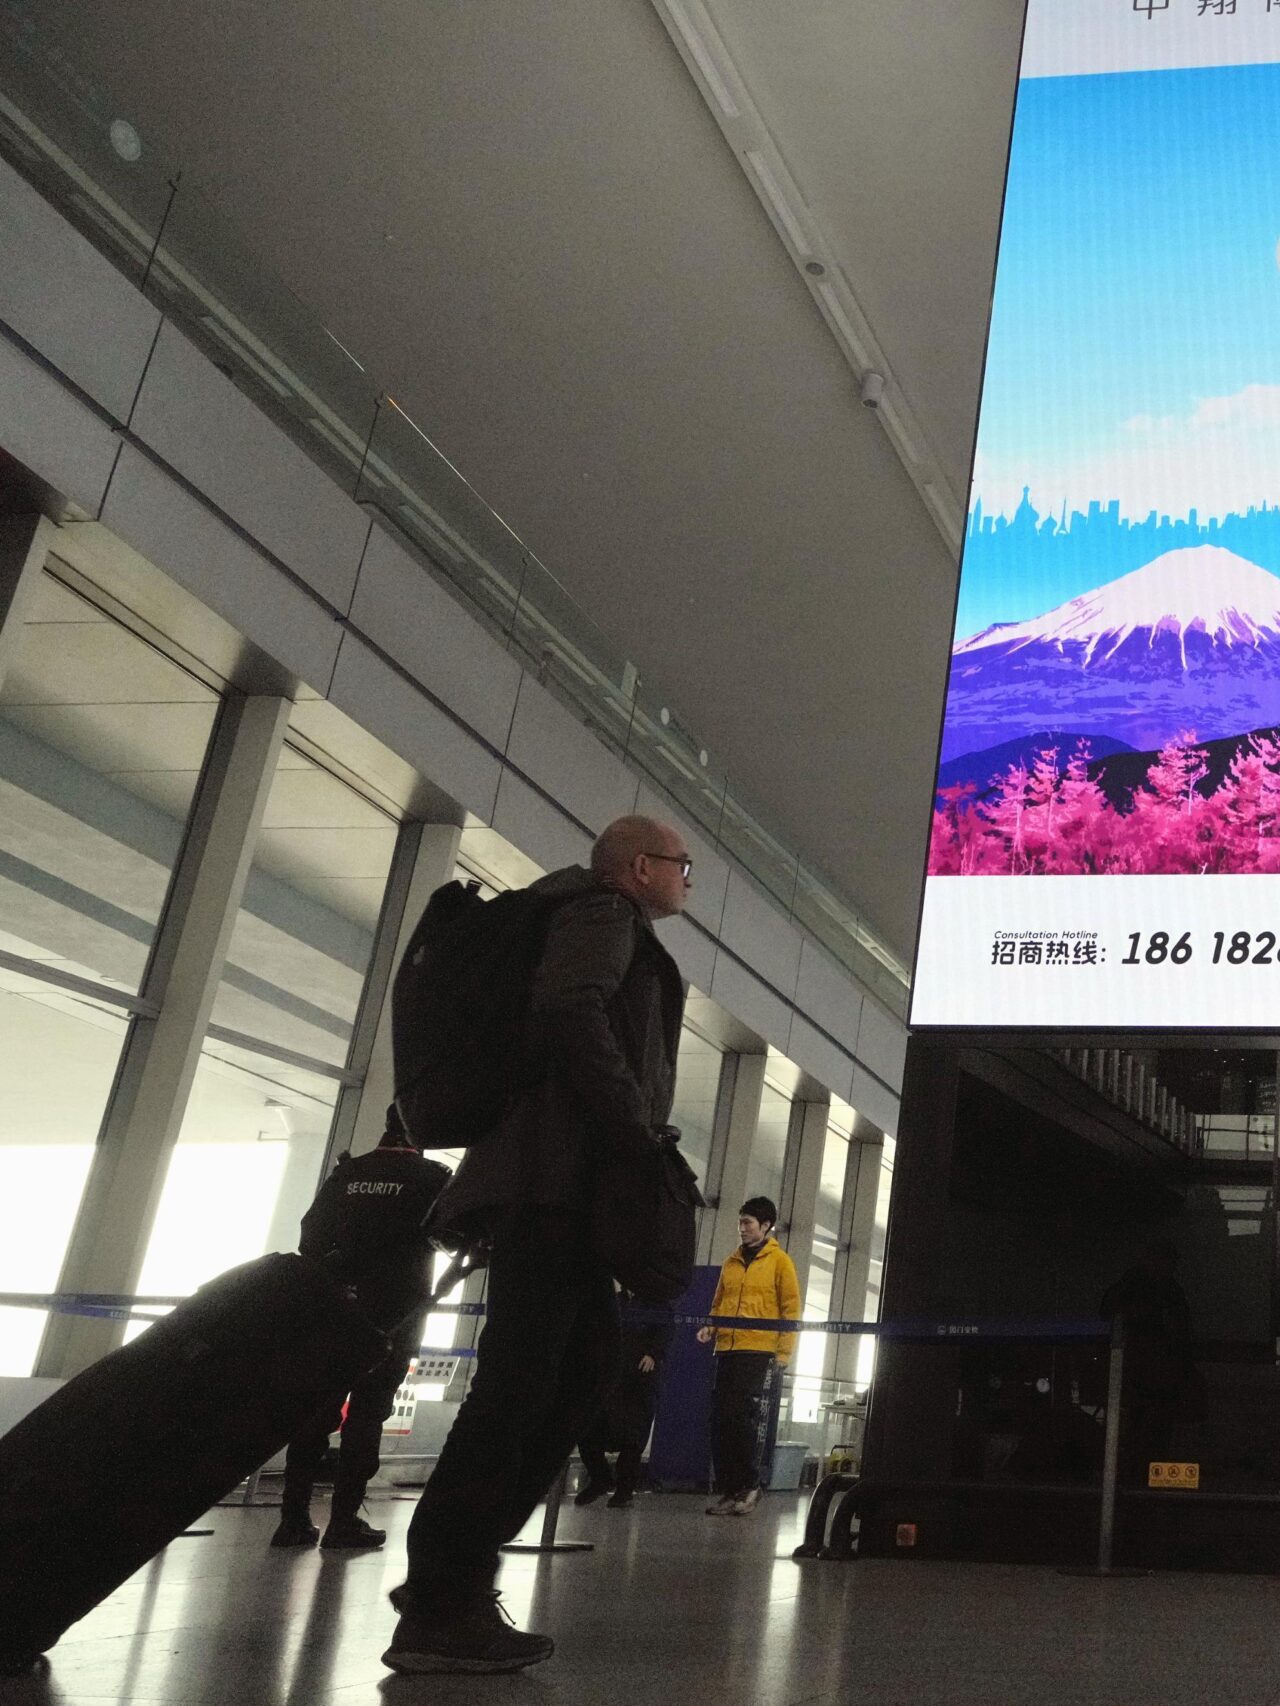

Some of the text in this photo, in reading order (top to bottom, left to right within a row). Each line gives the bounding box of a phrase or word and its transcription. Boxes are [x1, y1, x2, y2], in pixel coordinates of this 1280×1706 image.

[994, 930, 1098, 939] Consultation Hotline
[1121, 931, 1193, 965] 186
[347, 1182, 403, 1195] SECURITY
